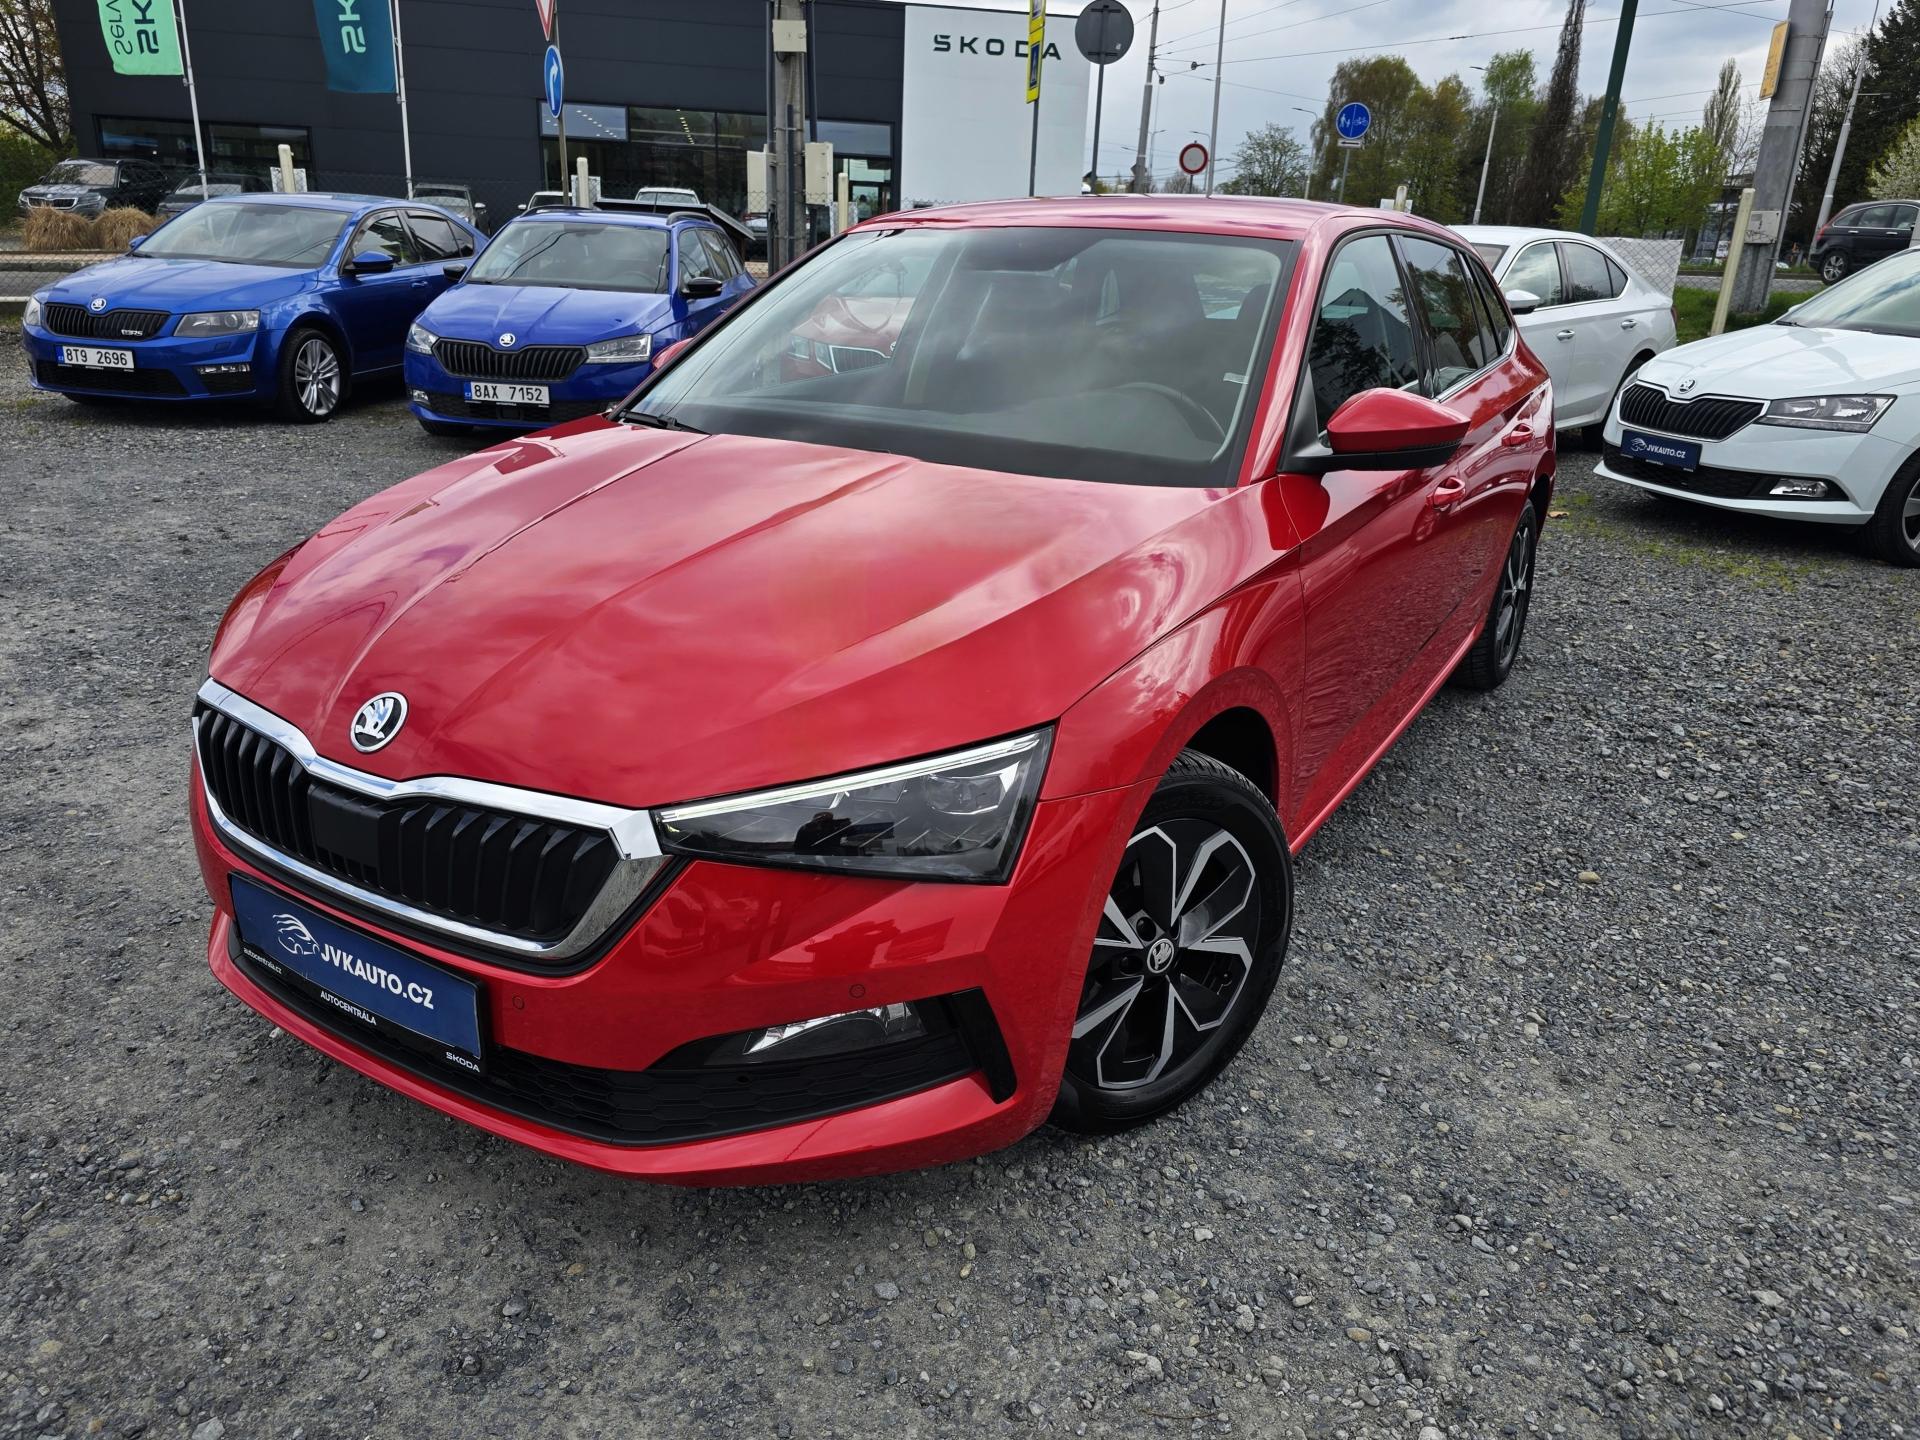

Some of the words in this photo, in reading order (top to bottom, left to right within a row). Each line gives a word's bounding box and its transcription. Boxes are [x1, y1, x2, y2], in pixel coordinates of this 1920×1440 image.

[65, 348, 88, 363] 8T9
[96, 350, 128, 366] 2696
[474, 384, 499, 399] 8AX
[508, 386, 544, 402] 7152
[1646, 444, 1686, 459] JVKAUTO.CZ
[321, 943, 434, 1010] JVKAUTO.CZ
[320, 990, 377, 1026] AUTOCENTRÁLA
